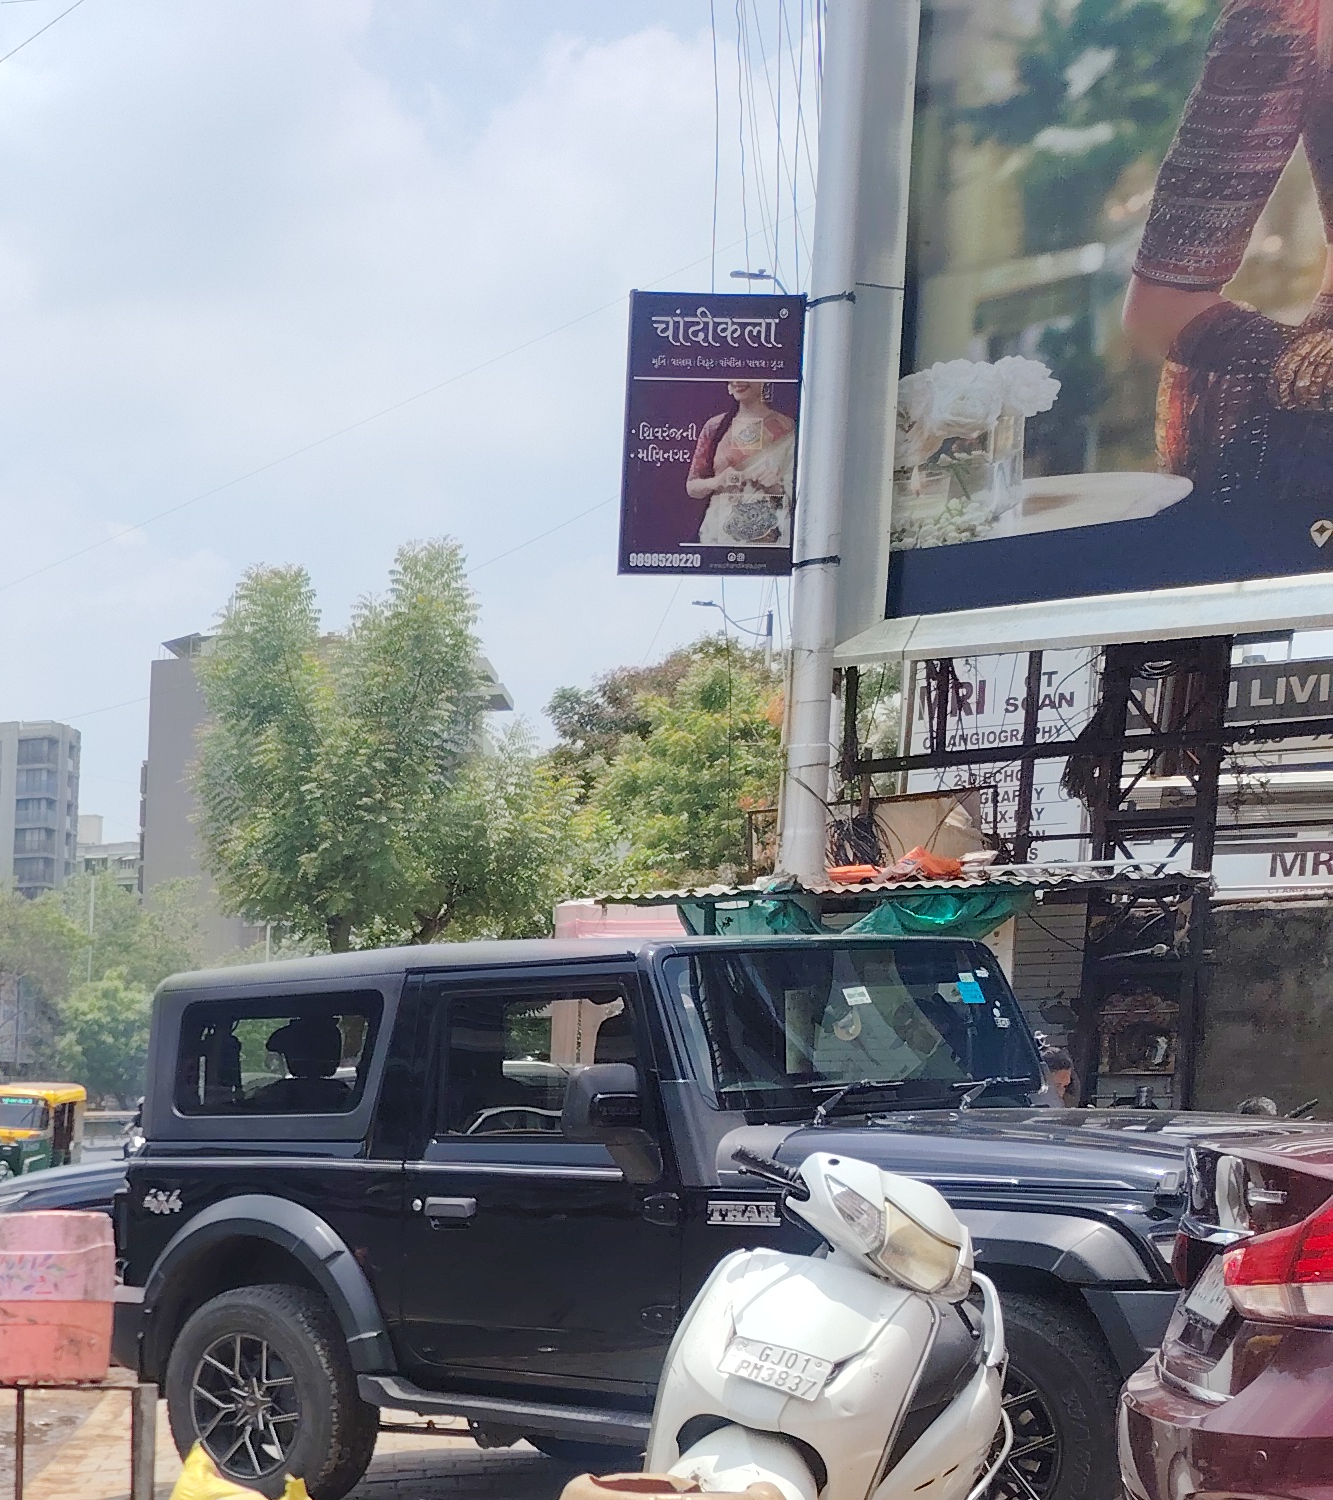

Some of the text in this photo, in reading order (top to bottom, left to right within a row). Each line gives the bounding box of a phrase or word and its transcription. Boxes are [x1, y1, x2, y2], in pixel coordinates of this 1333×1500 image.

[651, 307, 783, 348] चांदीकला
[639, 421, 698, 442] શિવરંજની
[637, 444, 691, 467] મણિનગર
[629, 552, 701, 568] 9898520220
[1004, 691, 1075, 714] SAN
[707, 1201, 781, 1226] THAR
[758, 1345, 812, 1374] GJ01
